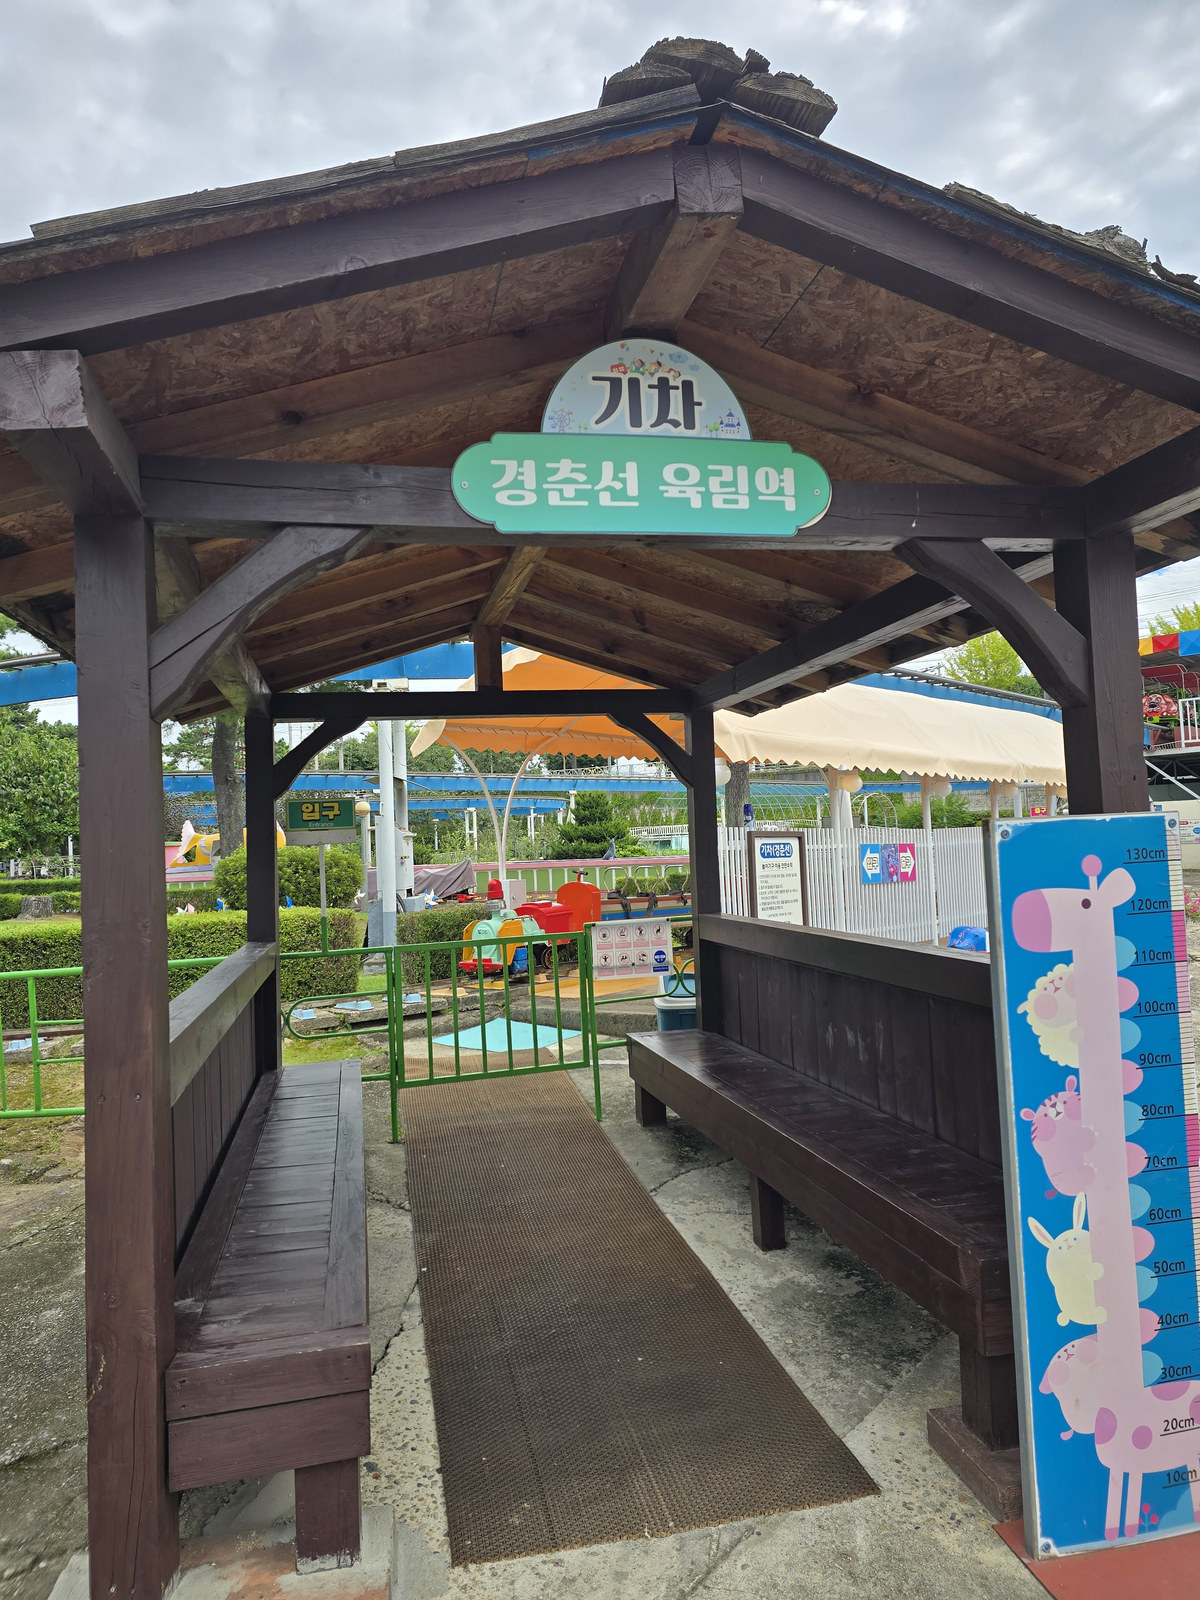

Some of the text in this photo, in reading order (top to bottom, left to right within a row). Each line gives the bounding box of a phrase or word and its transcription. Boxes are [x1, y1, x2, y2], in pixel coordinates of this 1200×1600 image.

[592, 375, 703, 430] 기차
[490, 458, 797, 512] 경춘선 육림역
[301, 802, 341, 821] 입구
[760, 843, 792, 857] 기차(경춘선)
[1126, 848, 1165, 861] 130cm
[866, 856, 879, 871] 입구
[1130, 898, 1169, 912] 120cm
[1134, 949, 1173, 963] 110cm
[1137, 1000, 1176, 1014] 100cm
[1139, 1052, 1172, 1066] 90cm
[1141, 1103, 1175, 1117] 80cm
[1144, 1155, 1178, 1169] 70cm
[1149, 1207, 1182, 1221] 60cm
[1153, 1260, 1186, 1274] 50cm
[1157, 1312, 1189, 1327] 40cm
[1160, 1364, 1192, 1380] 30cm
[1163, 1416, 1195, 1432] 20cm
[1166, 1469, 1197, 1484] 10cm
